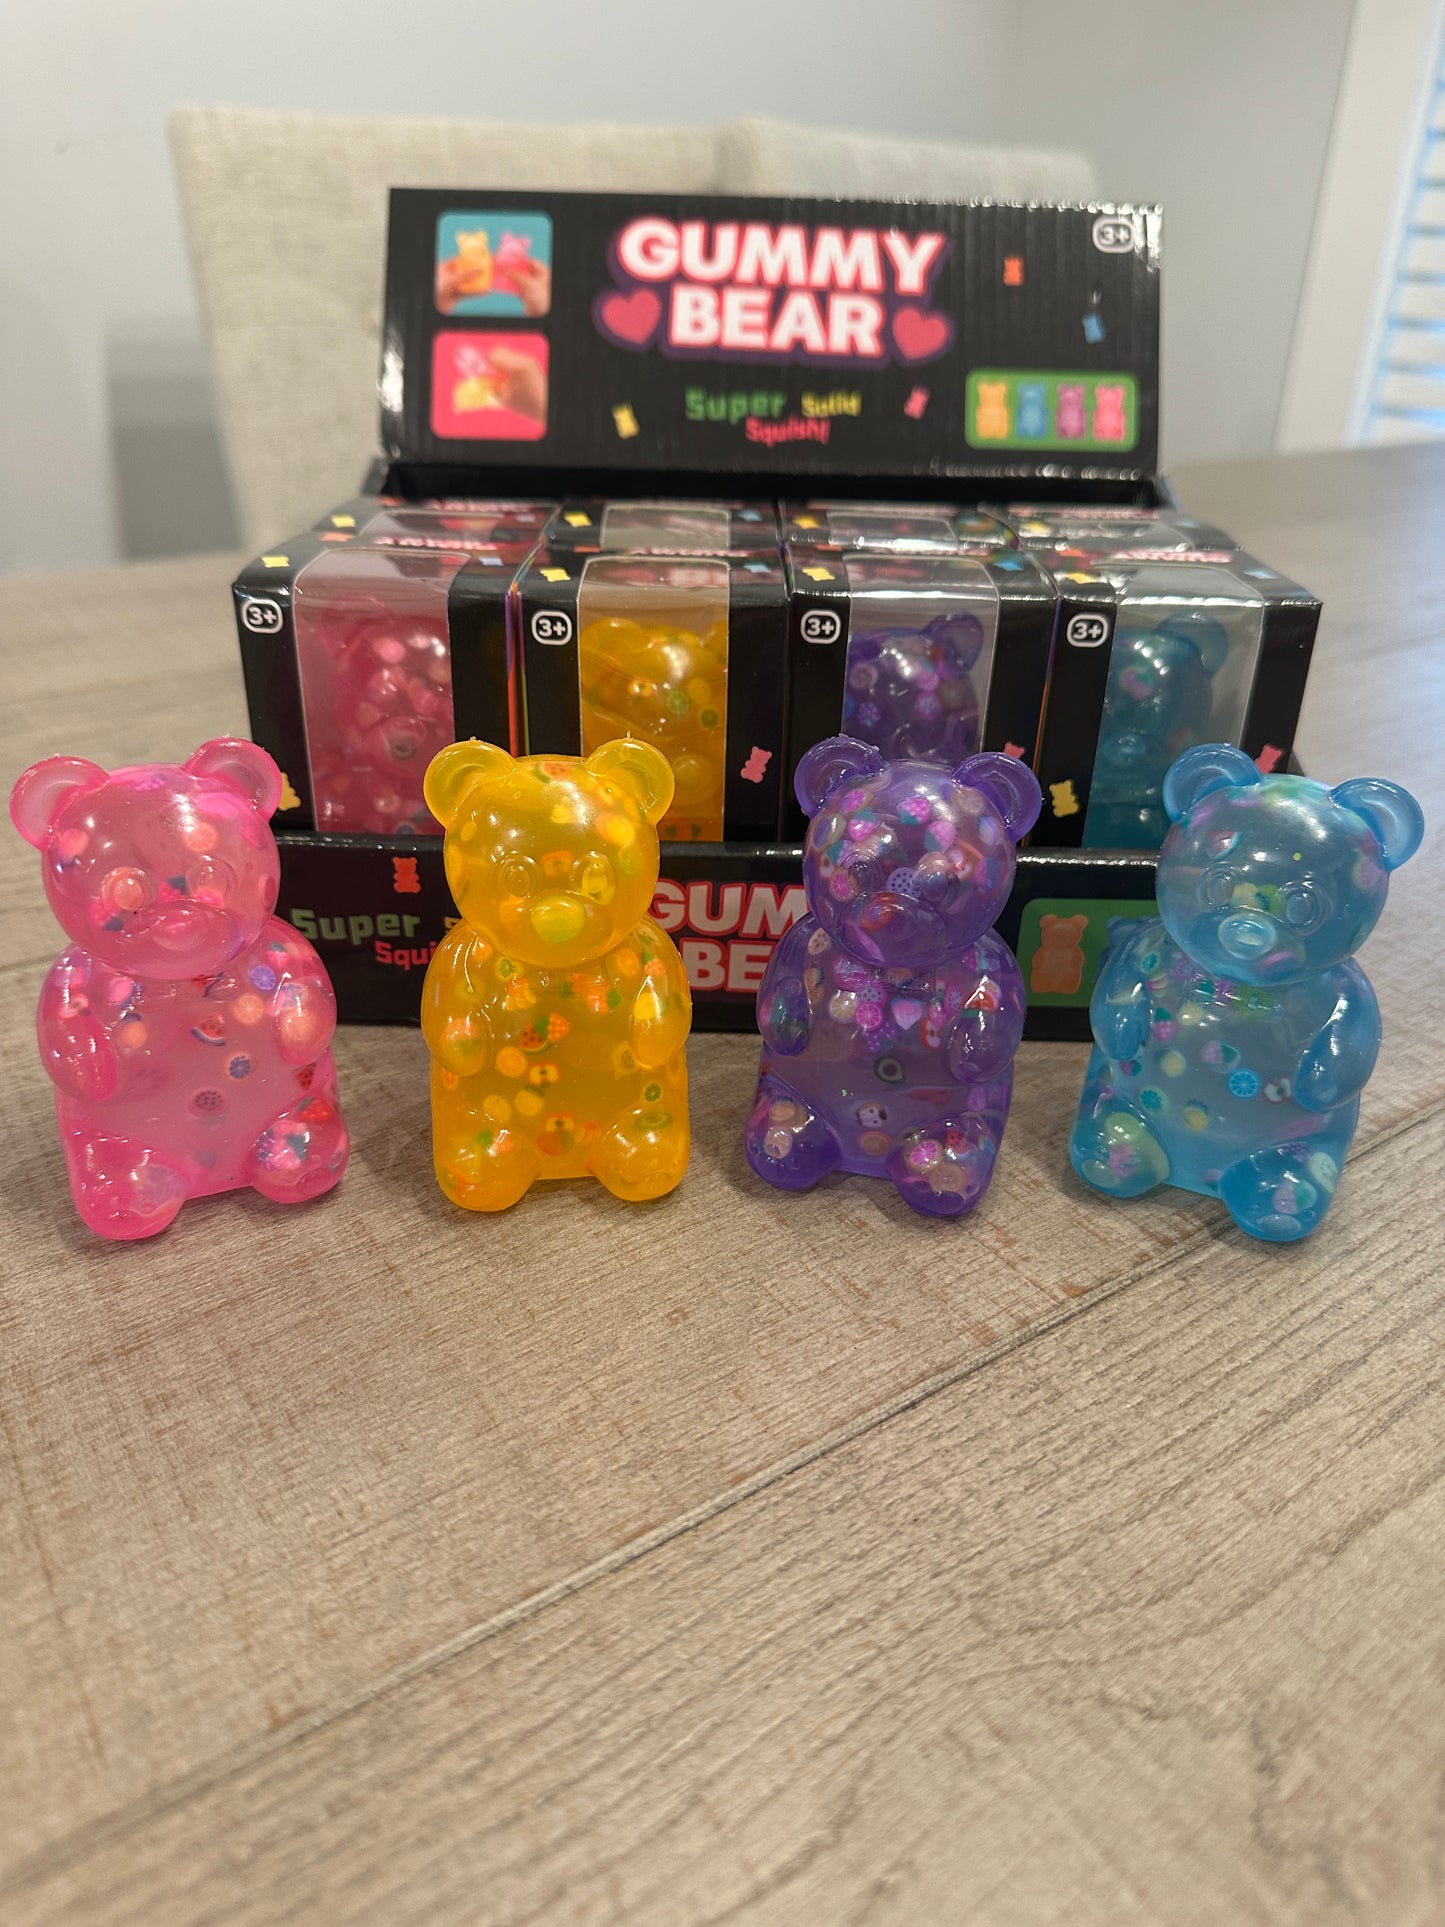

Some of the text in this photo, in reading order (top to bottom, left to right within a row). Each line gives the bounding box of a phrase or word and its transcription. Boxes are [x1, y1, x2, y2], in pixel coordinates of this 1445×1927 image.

[1101, 226, 1130, 245] 3+
[619, 217, 943, 296] GUMMY
[669, 283, 883, 356] BEAR
[685, 388, 786, 424] Super
[248, 606, 277, 625] 3+
[538, 618, 566, 637] 3+
[807, 618, 835, 636] 3+
[1073, 622, 1102, 640] 3+
[650, 879, 811, 937] GUM
[291, 908, 421, 946] Super
[680, 938, 779, 992] BE
